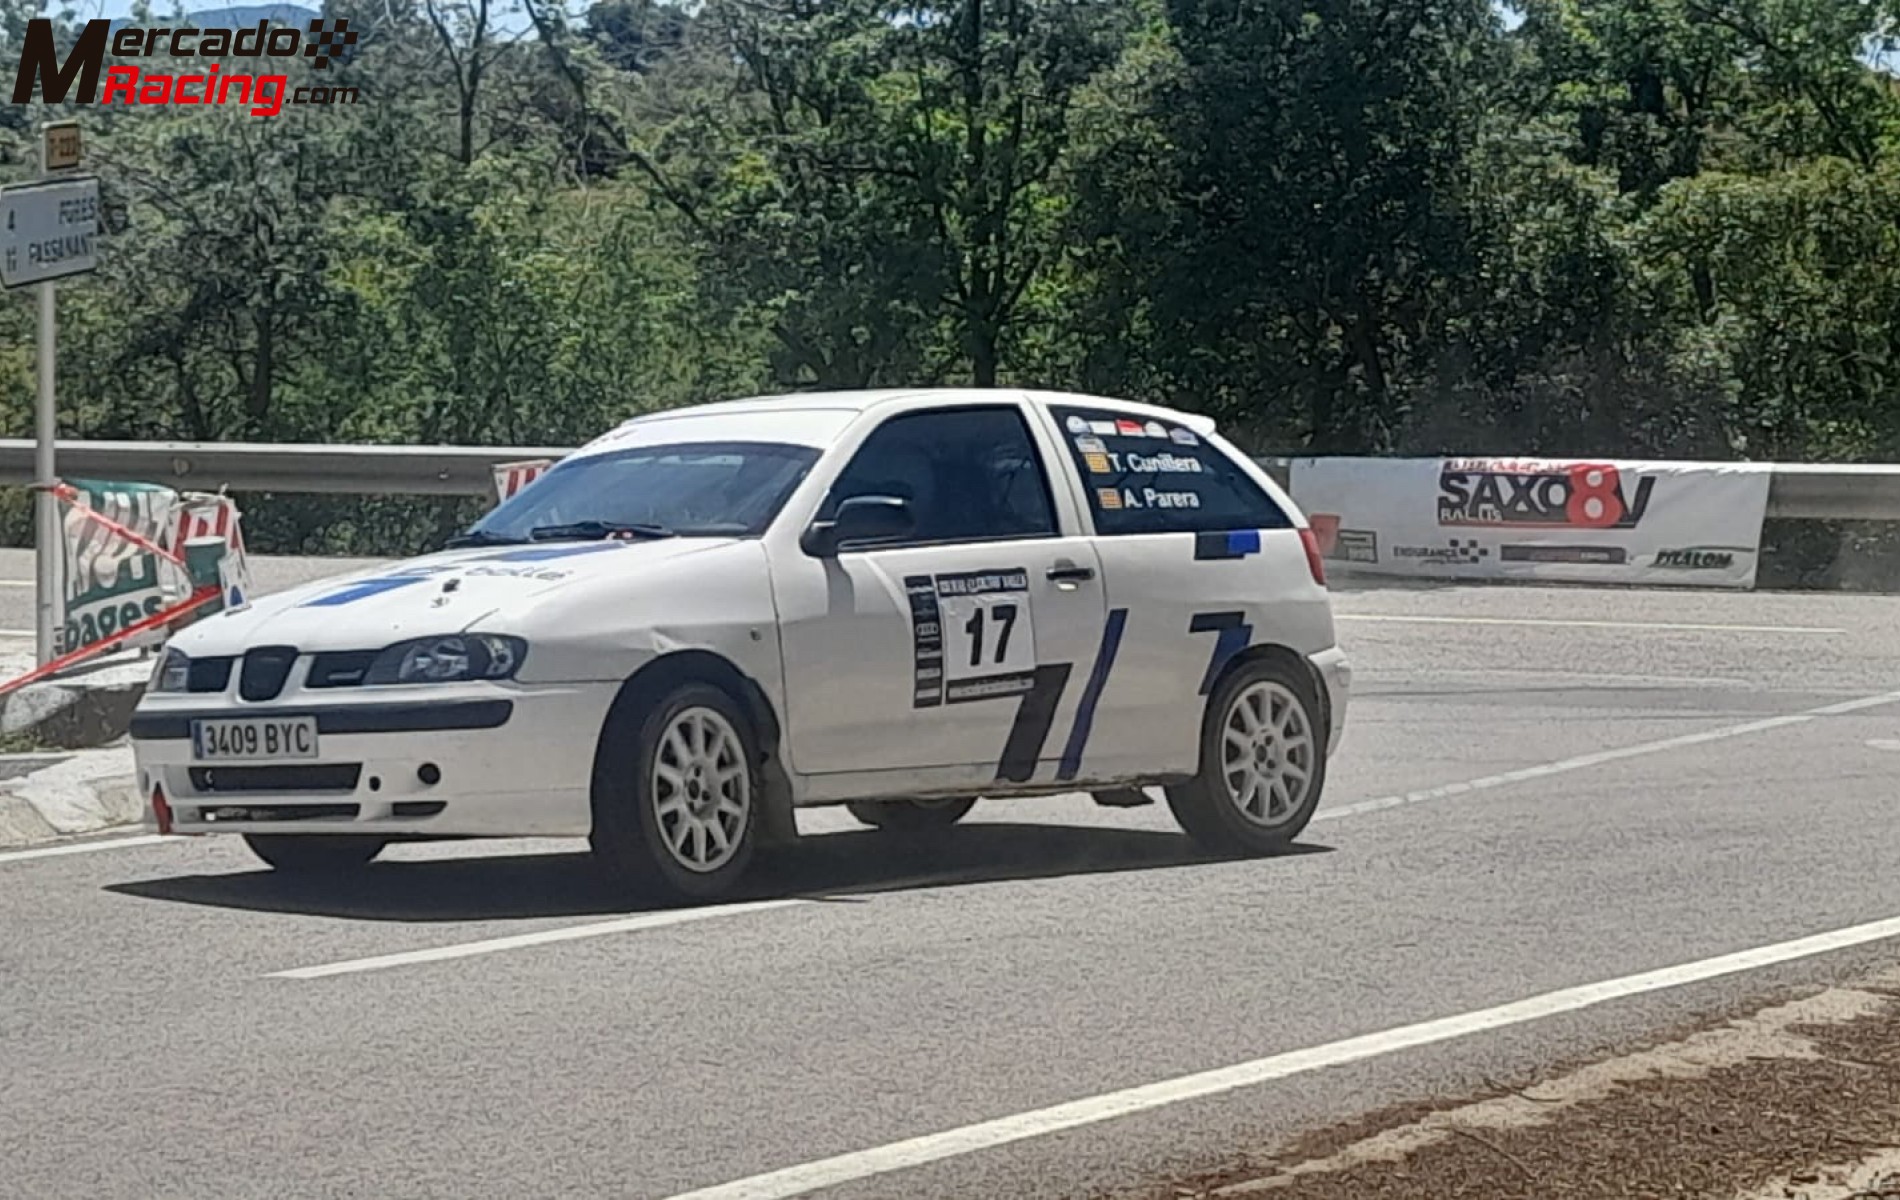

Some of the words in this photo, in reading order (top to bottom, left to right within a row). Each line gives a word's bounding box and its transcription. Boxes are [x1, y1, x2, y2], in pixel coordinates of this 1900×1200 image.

[1107, 452, 1127, 472] T.
[1126, 452, 1202, 473] Cunillera
[1124, 487, 1143, 508] A.
[1142, 487, 1200, 508] Parera
[965, 604, 1017, 667] 17
[205, 725, 258, 755] 3409
[264, 723, 310, 754] BYC
